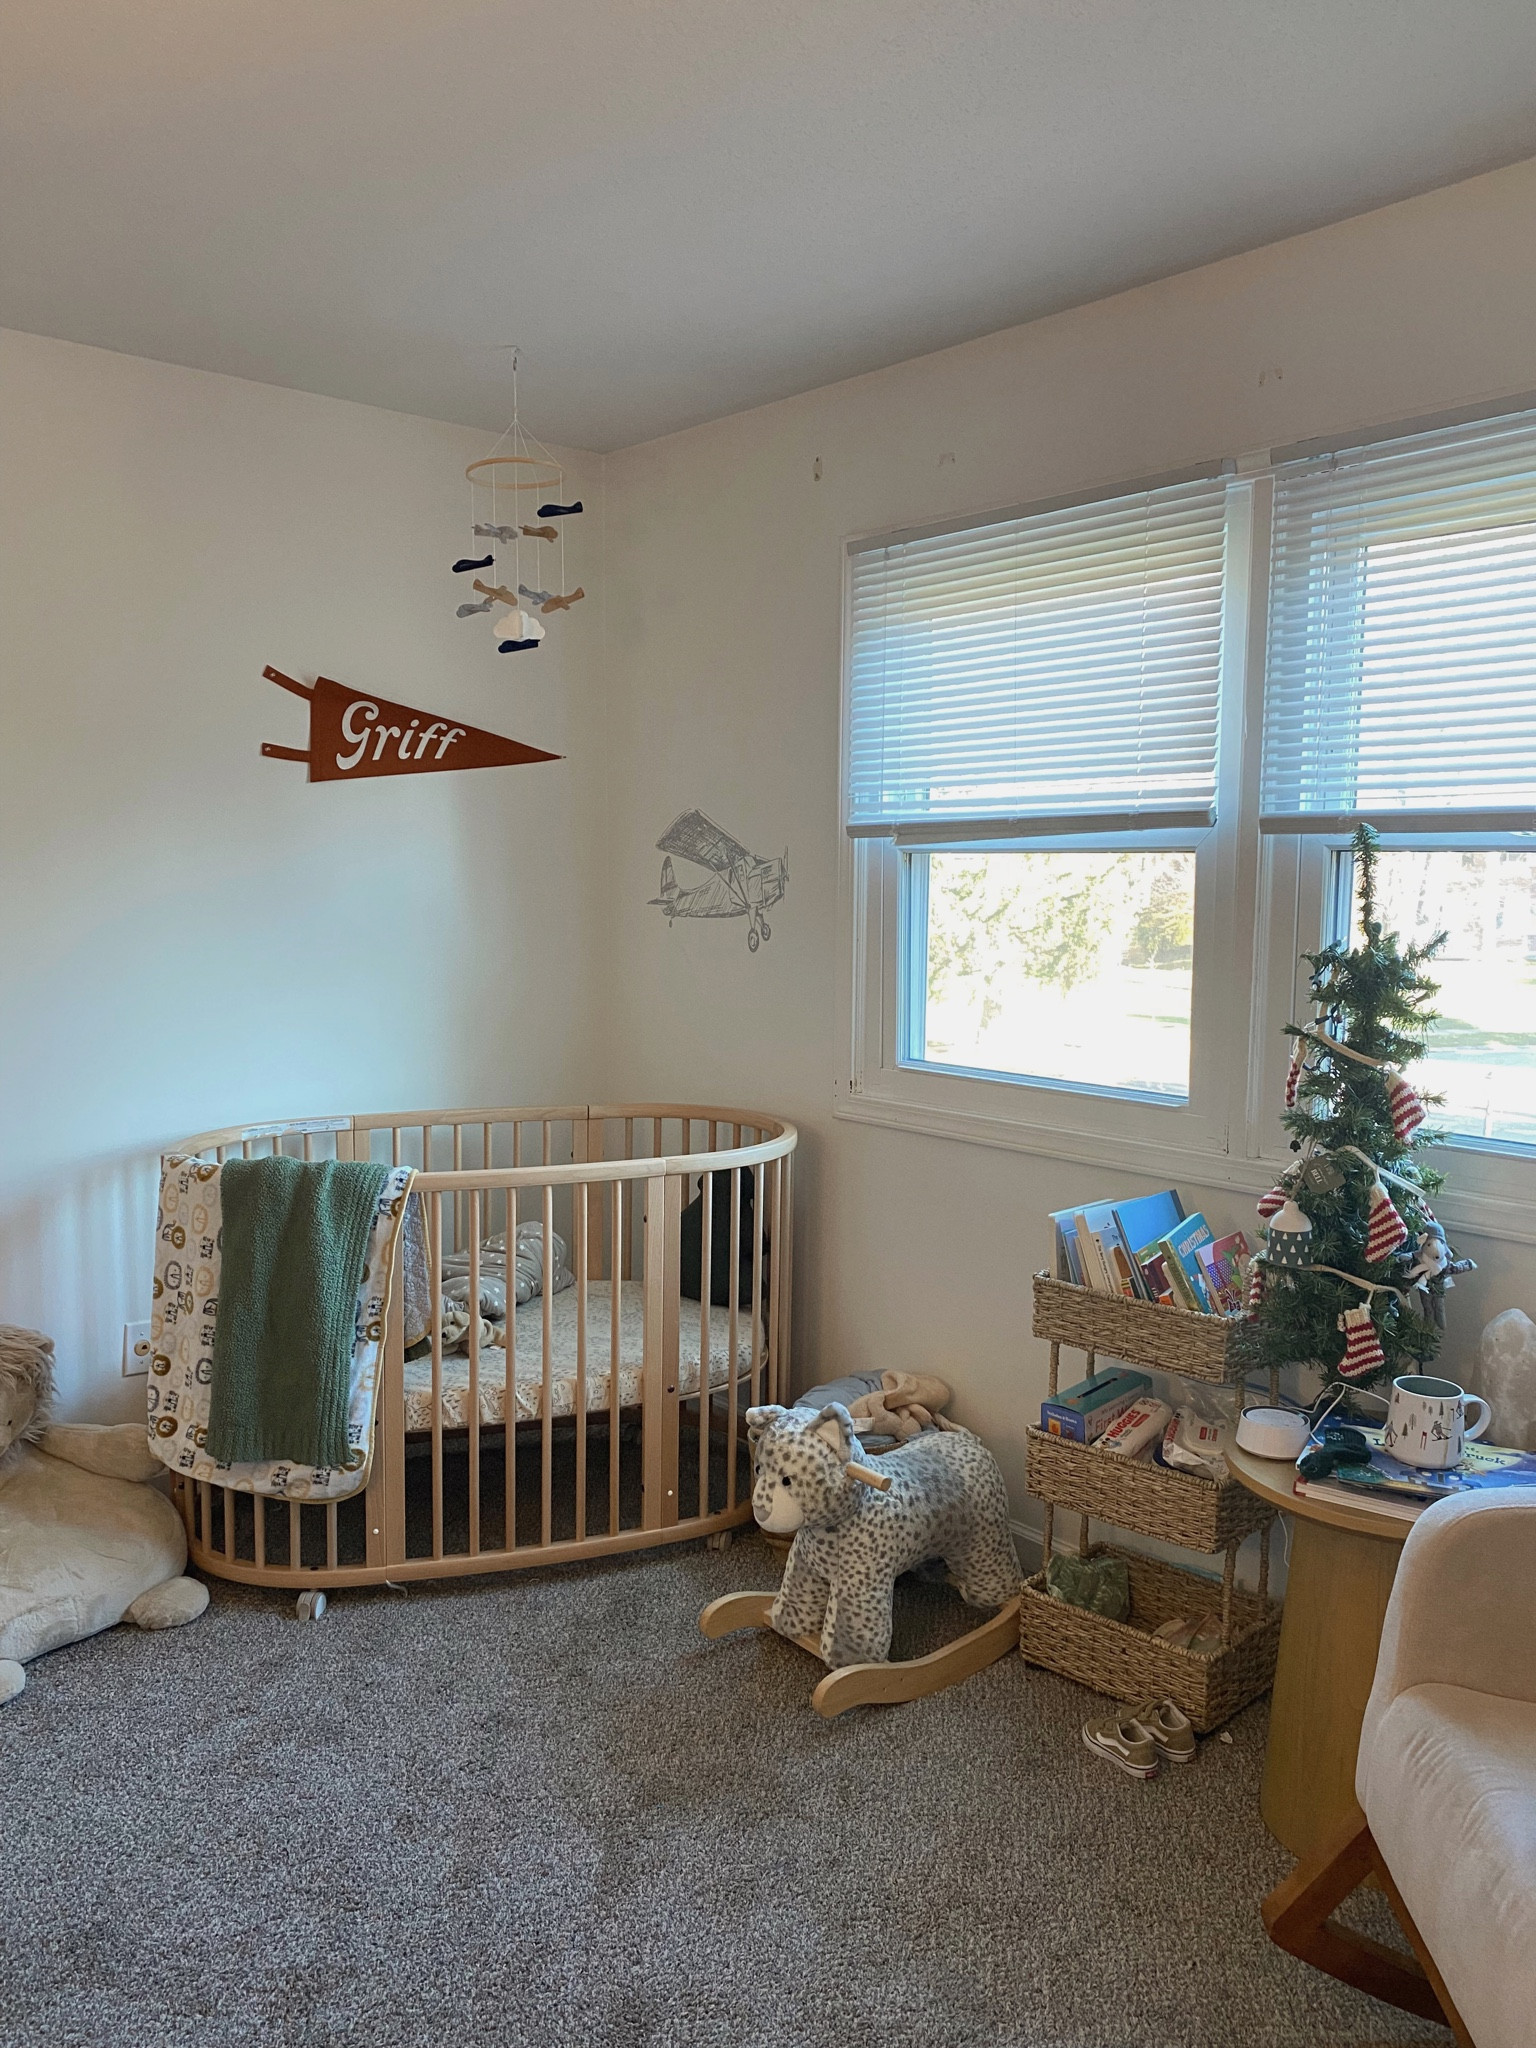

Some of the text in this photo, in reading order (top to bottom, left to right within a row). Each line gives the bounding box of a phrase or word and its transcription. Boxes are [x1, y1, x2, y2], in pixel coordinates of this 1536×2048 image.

[336, 700, 467, 770] Griff
[1310, 1168, 1323, 1185] BELL
[1178, 1224, 1210, 1258] CHRISTMAS
[1106, 1409, 1141, 1438] HUGGIES
[1464, 1450, 1506, 1465] ruck
